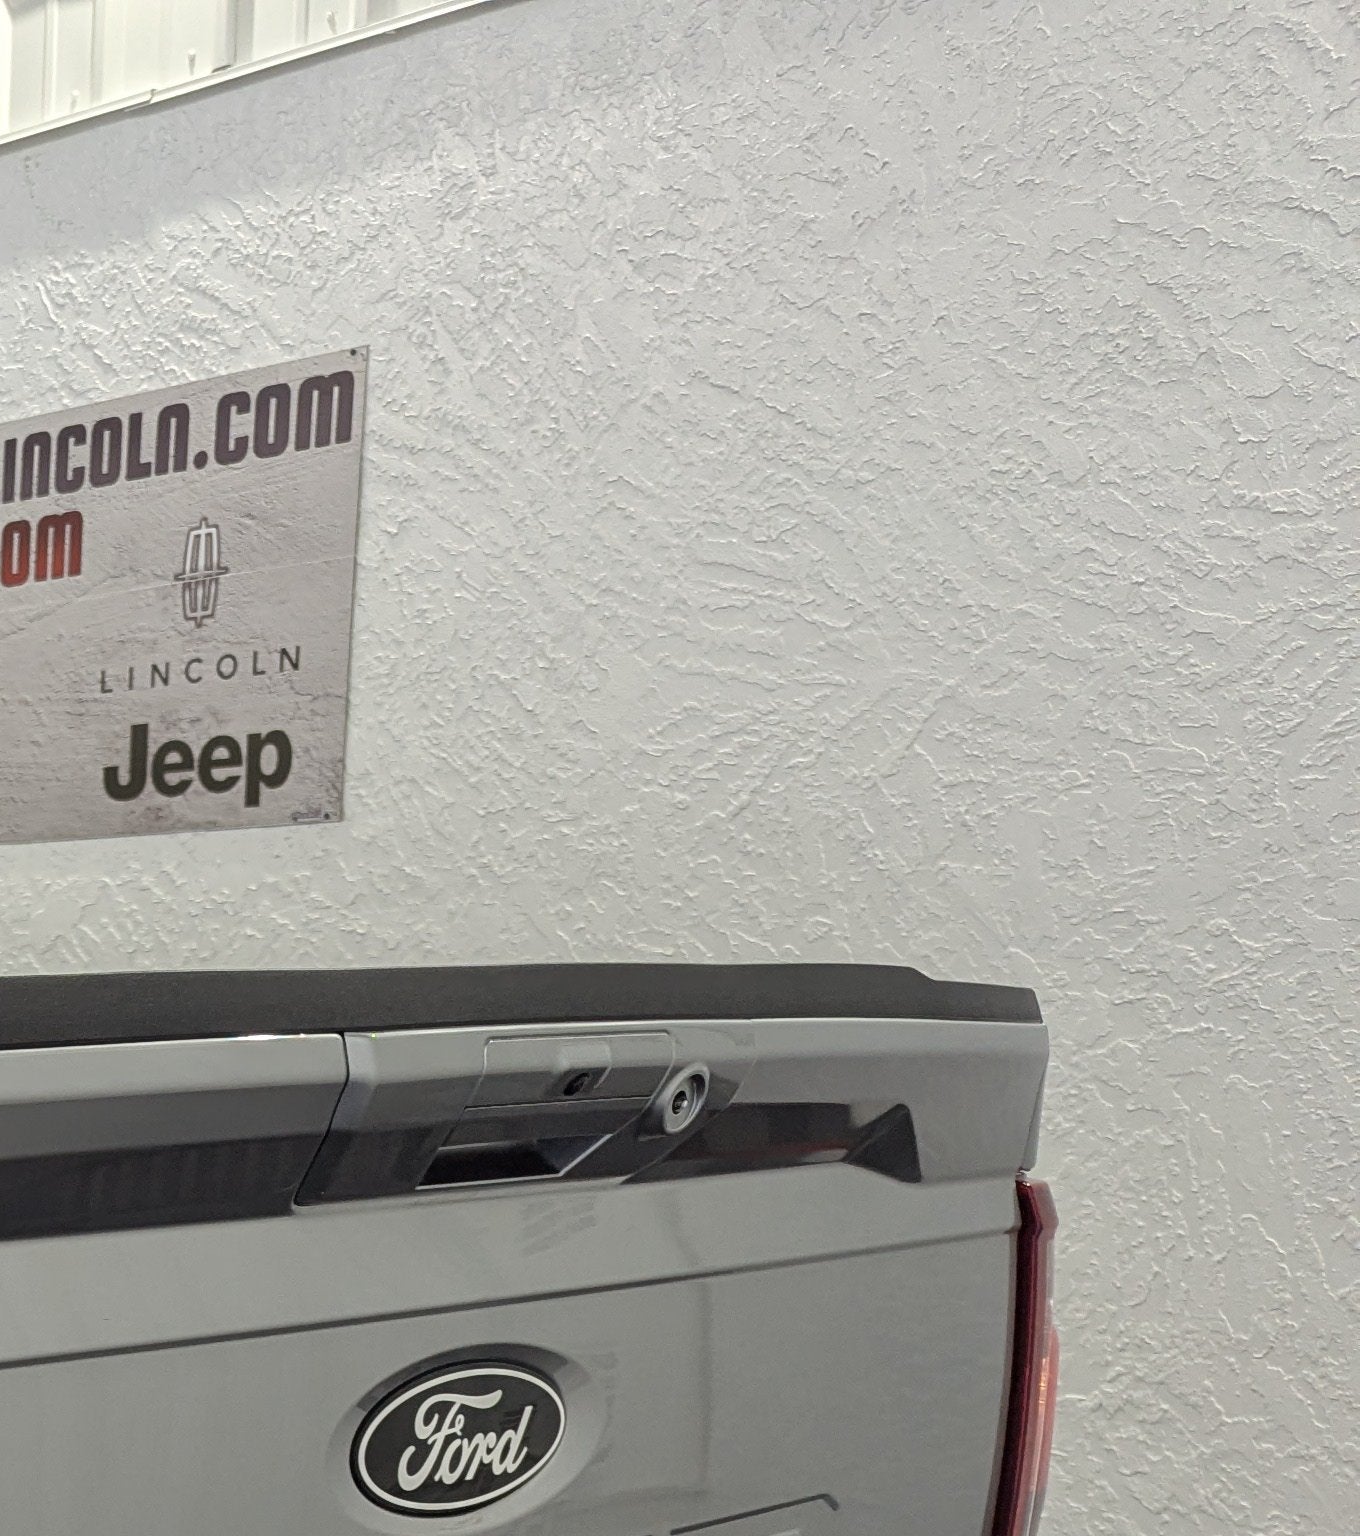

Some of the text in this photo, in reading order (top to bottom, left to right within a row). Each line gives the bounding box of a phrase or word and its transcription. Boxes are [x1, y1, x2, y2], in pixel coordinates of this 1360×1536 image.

[99, 645, 301, 694] LINCOLN
[102, 723, 293, 809] Jeep
[397, 1389, 534, 1492] Ford
